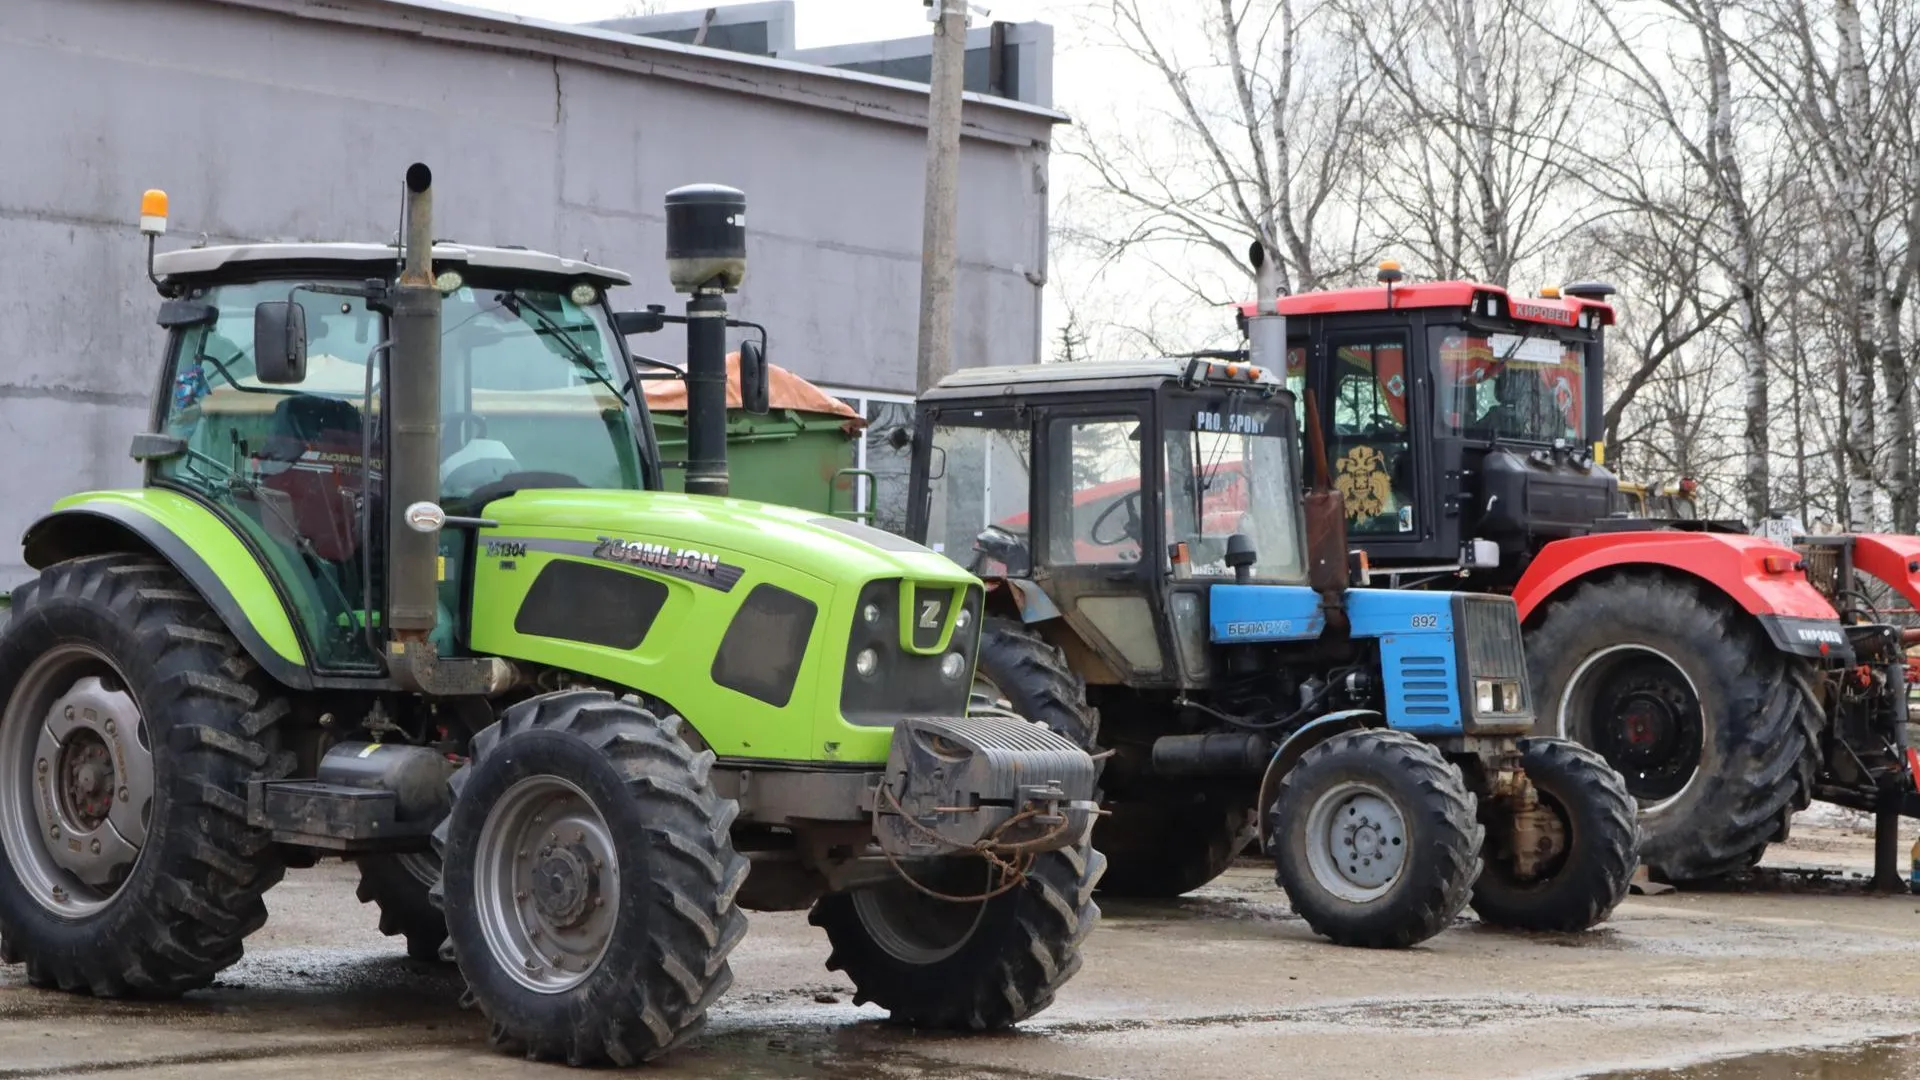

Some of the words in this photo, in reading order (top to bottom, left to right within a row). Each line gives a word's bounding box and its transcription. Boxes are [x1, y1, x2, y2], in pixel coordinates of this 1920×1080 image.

[1516, 303, 1570, 324] КИРОВЕЦ
[1198, 411, 1222, 431] PRO.
[593, 535, 719, 578] ZOOMLION
[919, 600, 941, 628] Z
[1411, 614, 1437, 628] 892
[1228, 620, 1292, 636] БЕЛАРУС
